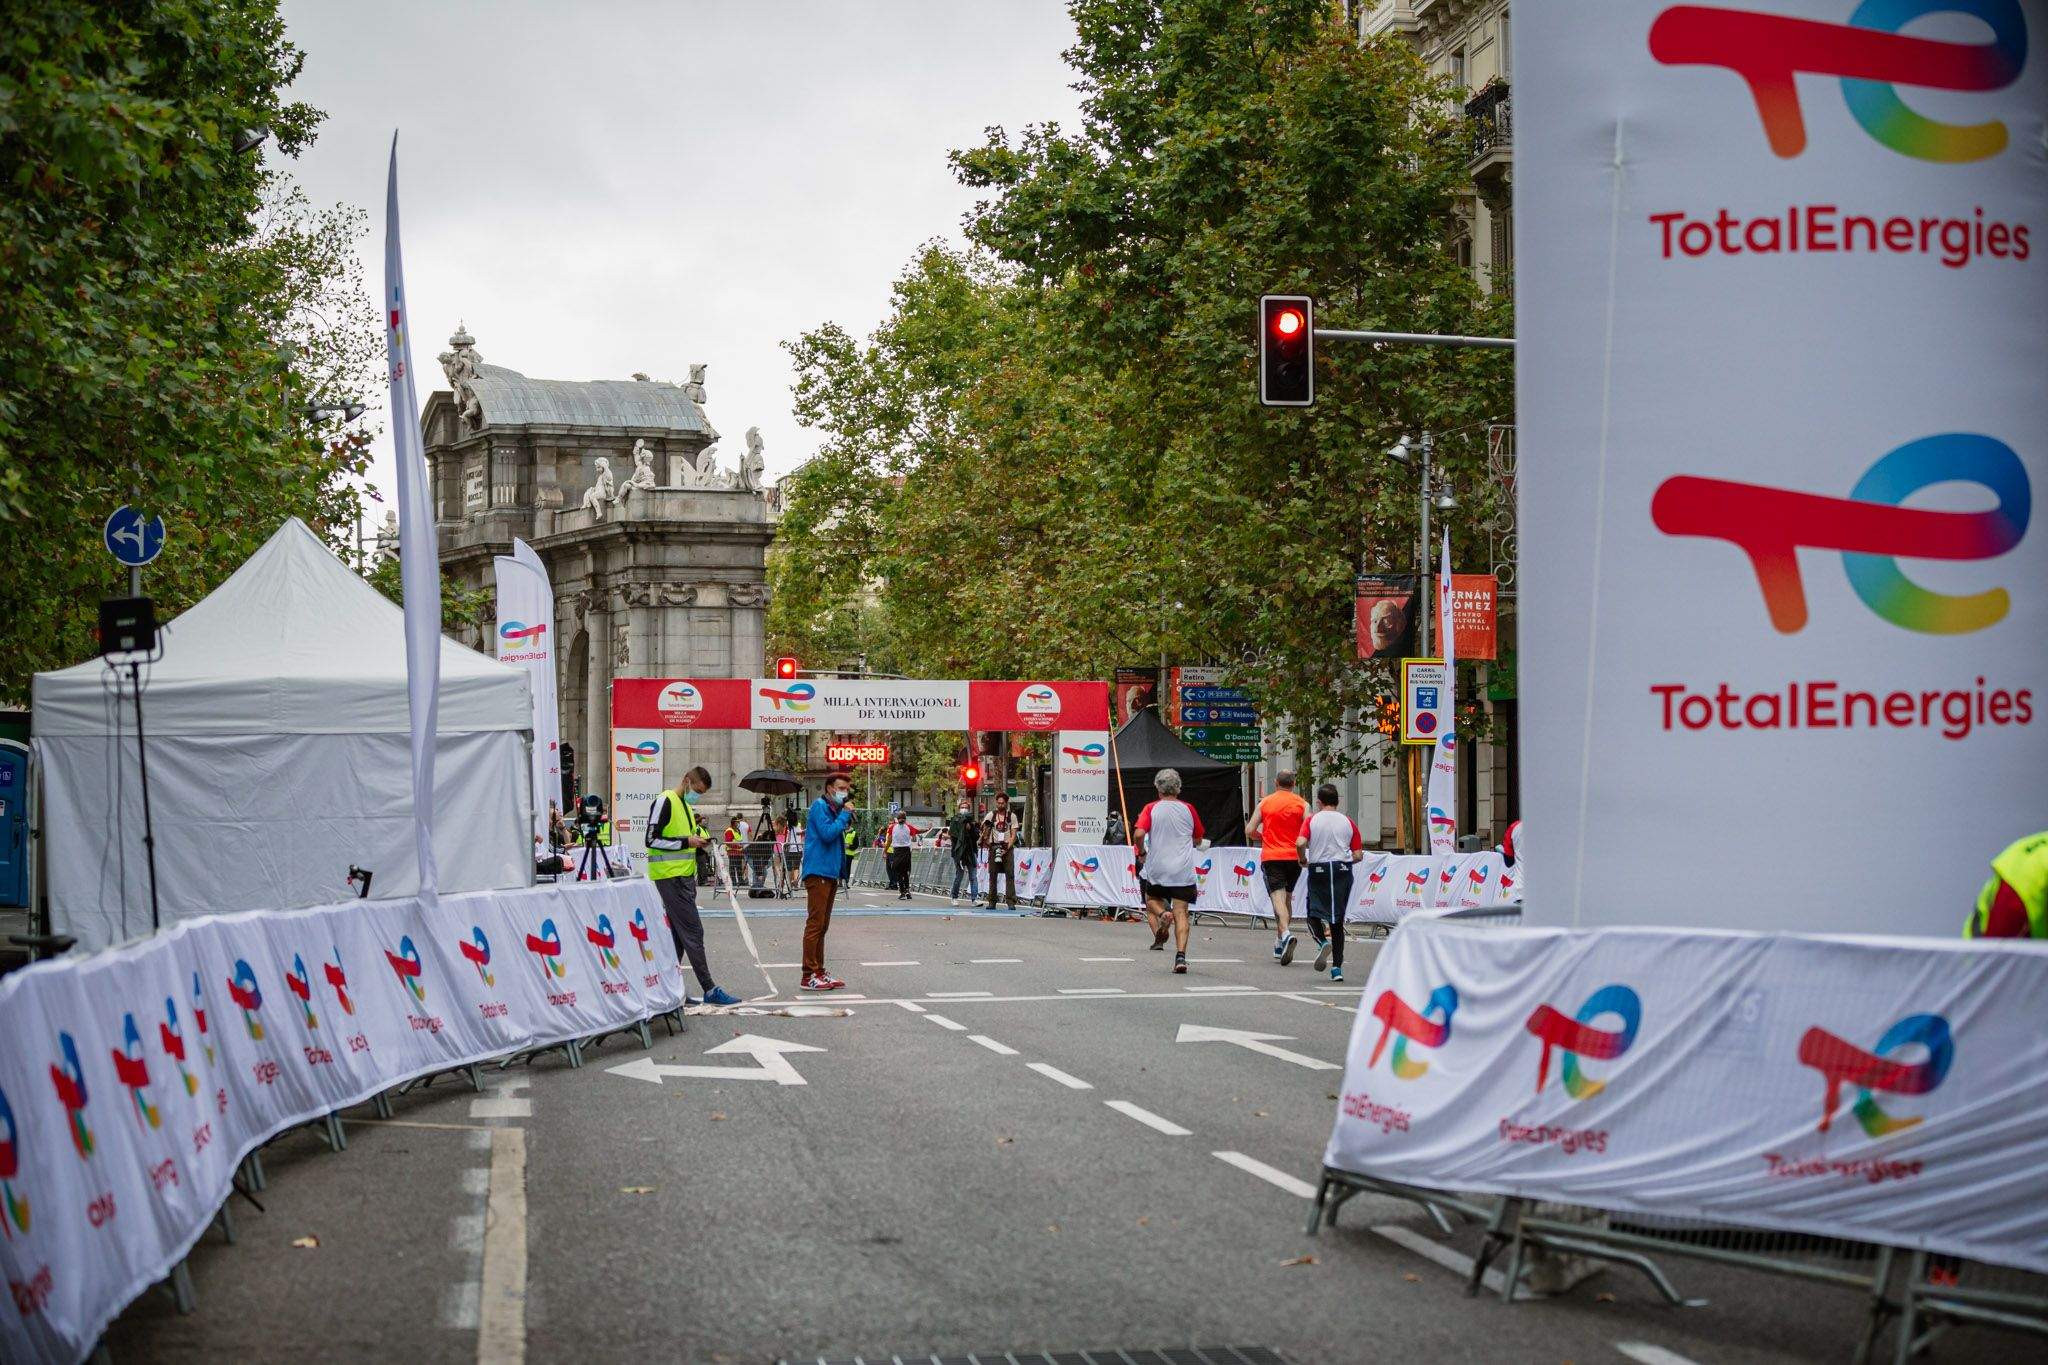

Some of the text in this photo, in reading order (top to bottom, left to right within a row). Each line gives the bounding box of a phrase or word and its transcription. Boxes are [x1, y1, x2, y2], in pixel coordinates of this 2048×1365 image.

[1649, 205, 2031, 268] TotalEnergies
[1451, 590, 1491, 600] ERNÁN
[1453, 600, 1491, 611] ÓMEZ
[823, 697, 860, 707] MILLA
[1650, 676, 2033, 740] TotalEnergies
[859, 709, 926, 719] DE MADRID
[759, 715, 816, 725] TotalEnergies
[615, 766, 660, 774] TotalEnergies
[1062, 767, 1106, 775] TotalEnergies
[1072, 794, 1107, 802] MADRID
